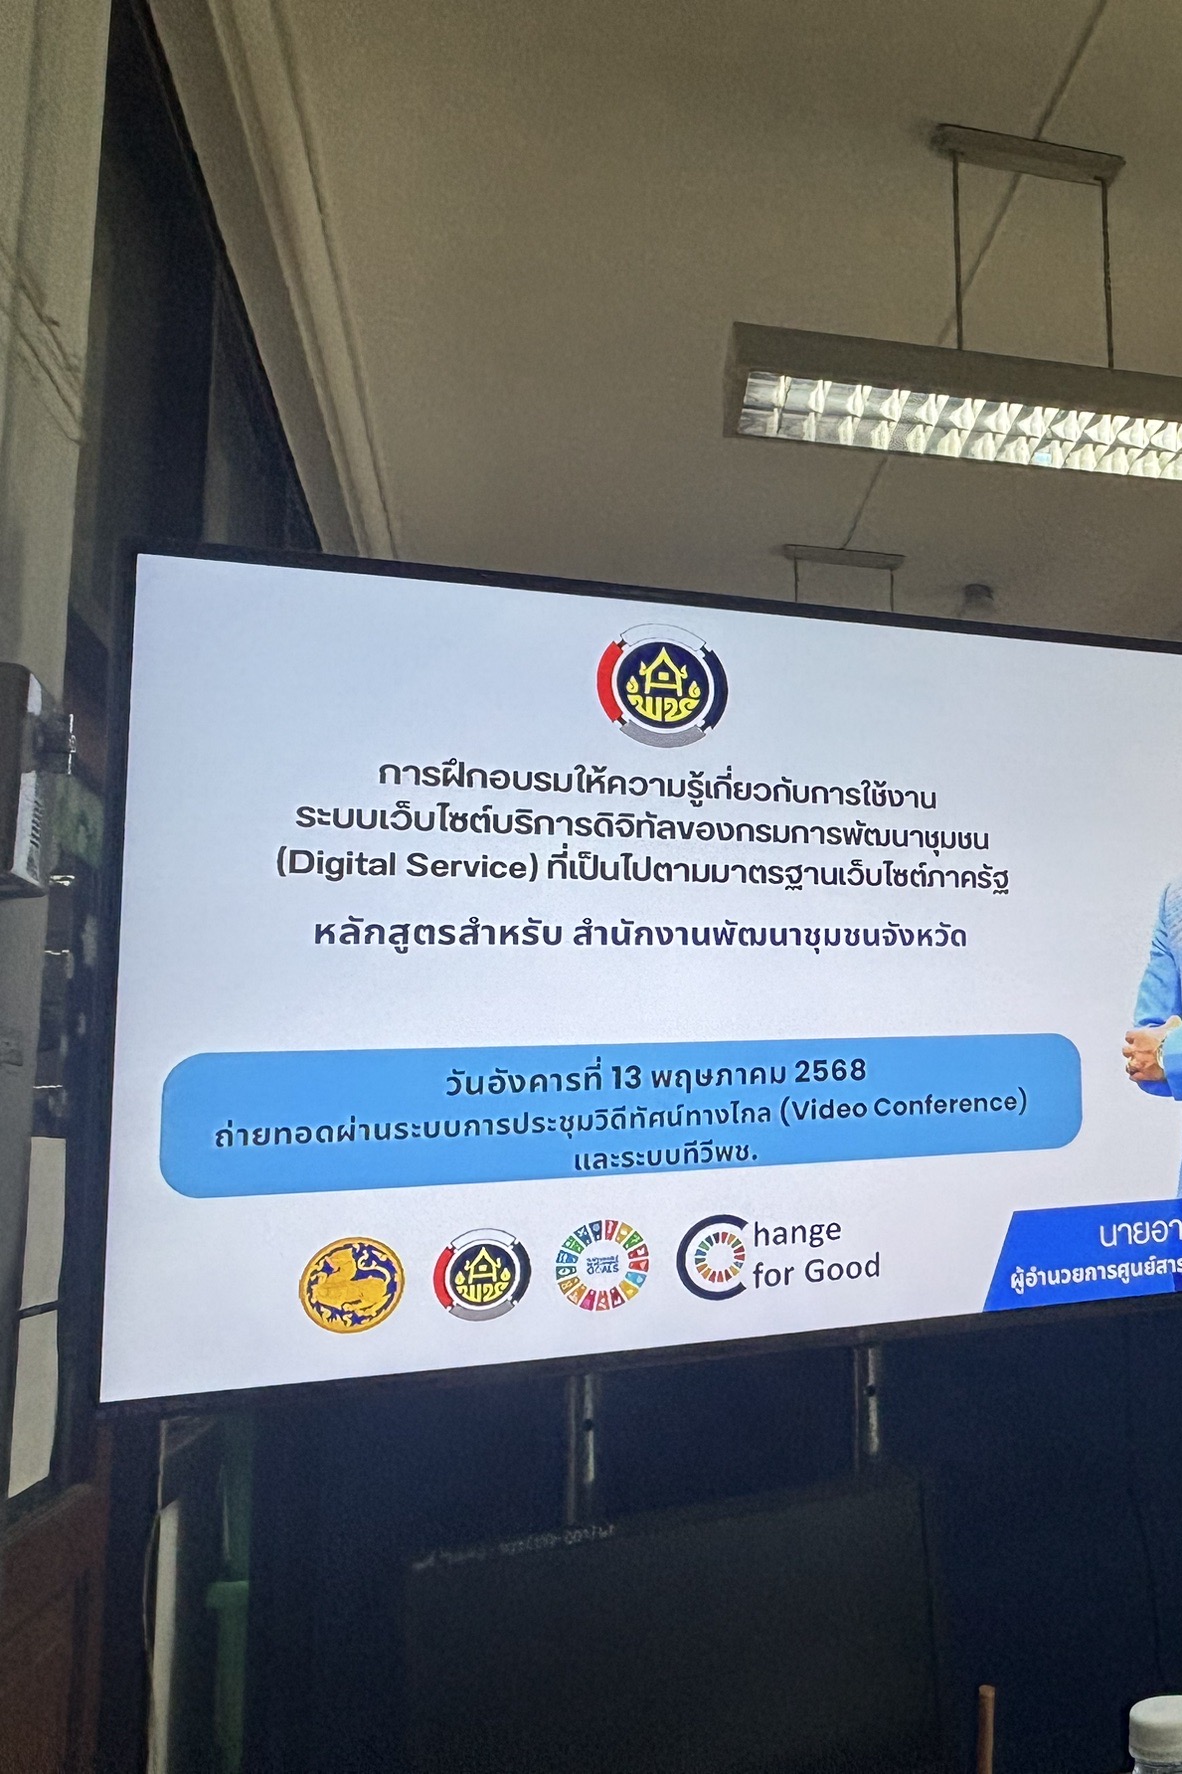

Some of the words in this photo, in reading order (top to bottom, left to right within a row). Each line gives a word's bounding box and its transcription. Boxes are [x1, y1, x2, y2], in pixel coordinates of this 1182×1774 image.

[379, 758, 937, 809] การฝึกอบรมให้ความรู้เกี่ยวกับการใช้งาน
[296, 801, 989, 856] ระบบเว็บไซต์บริการดิจิทัลของกรมการพัฒนาชุมชน
[277, 846, 396, 882] (Digital
[406, 852, 538, 882] Service)
[547, 843, 1009, 895] ที่เป็นไปตามมาตรฐานเว็บไซต์ภาครัฐ
[314, 915, 562, 954] หลักสูตรสำหรับ
[573, 917, 967, 954] สำนักงานพัฒนาชุมชนจังหวัด
[446, 1055, 602, 1096] วันอังคารที่
[611, 1065, 642, 1090] 13
[651, 1065, 786, 1096] พฤษภาคม
[795, 1059, 867, 1083] 2568
[215, 1100, 771, 1148] ถ่ายทอดผ่านระบบการประชุมวิดีทัศน์ทางไกล
[779, 1096, 868, 1127] (Video
[873, 1087, 1028, 1118] Conference)
[574, 1138, 758, 1172] และระบบทีวีพช.
[752, 1261, 795, 1289] for
[804, 1251, 880, 1283] Good
